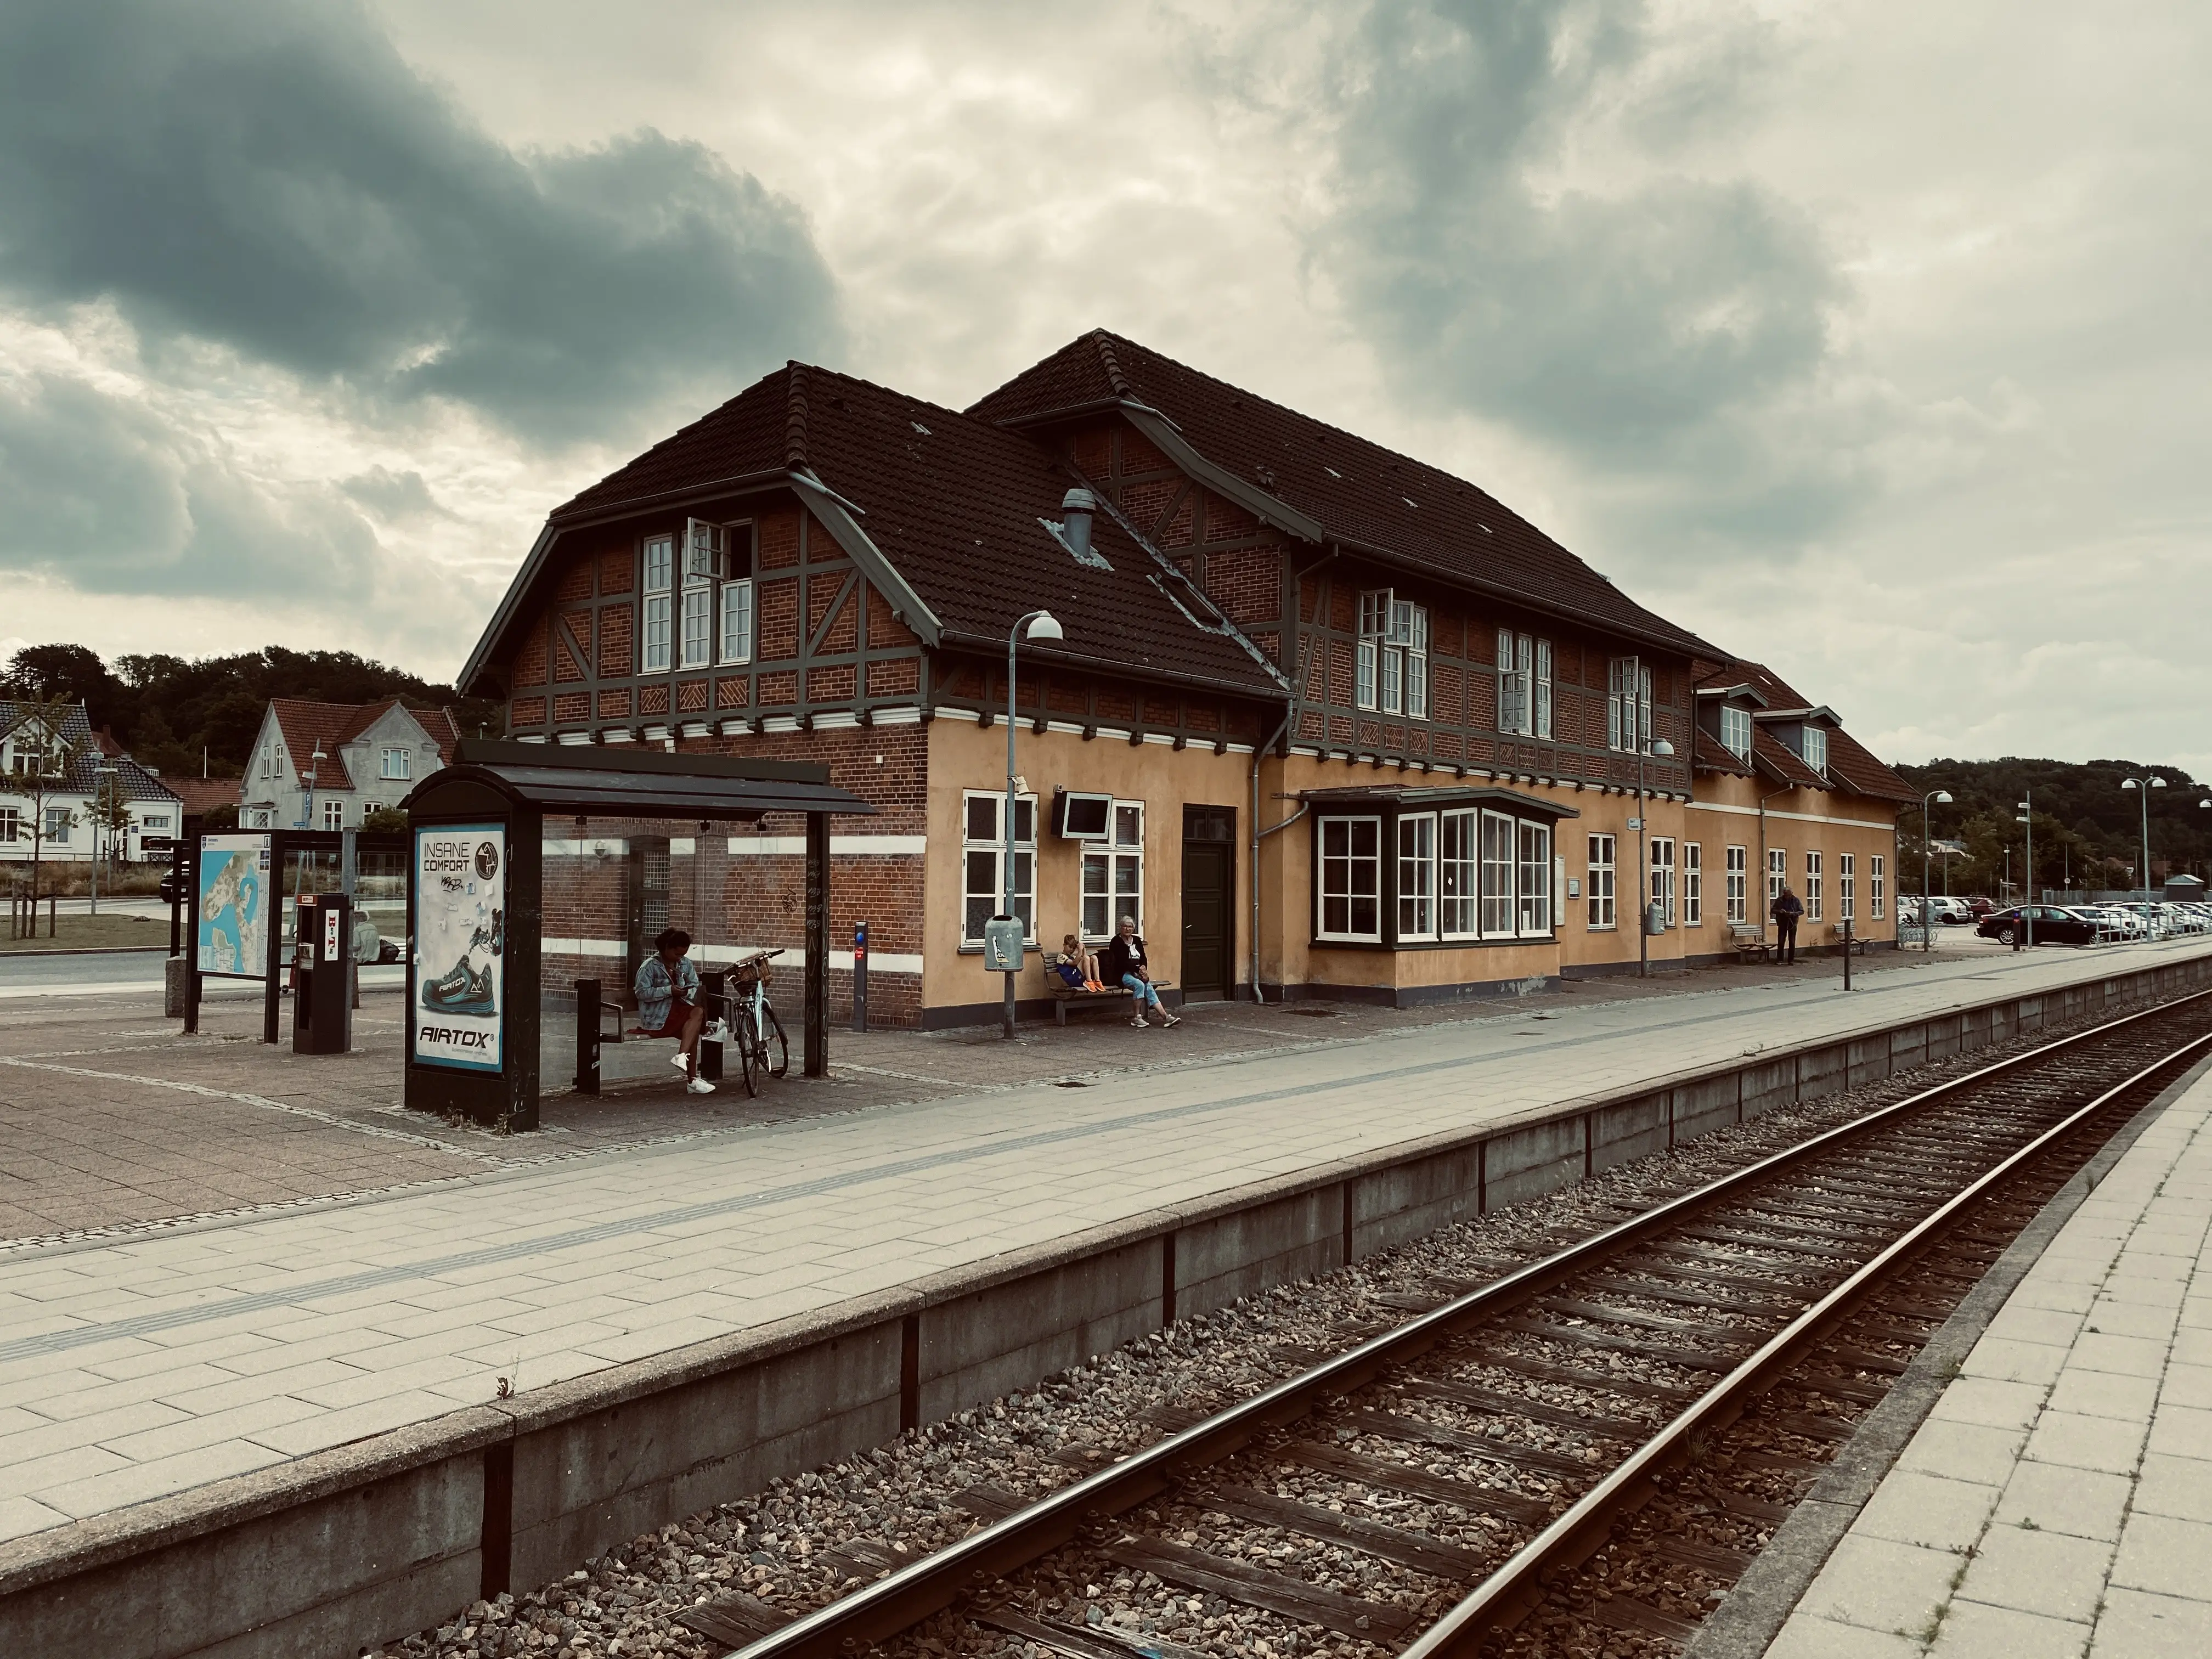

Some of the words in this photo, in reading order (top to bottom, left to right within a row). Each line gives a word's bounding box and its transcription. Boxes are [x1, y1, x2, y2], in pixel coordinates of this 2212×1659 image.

[425, 842, 470, 857] INSANE
[424, 860, 470, 871] COMFORT
[439, 977, 466, 992] AIRTOX
